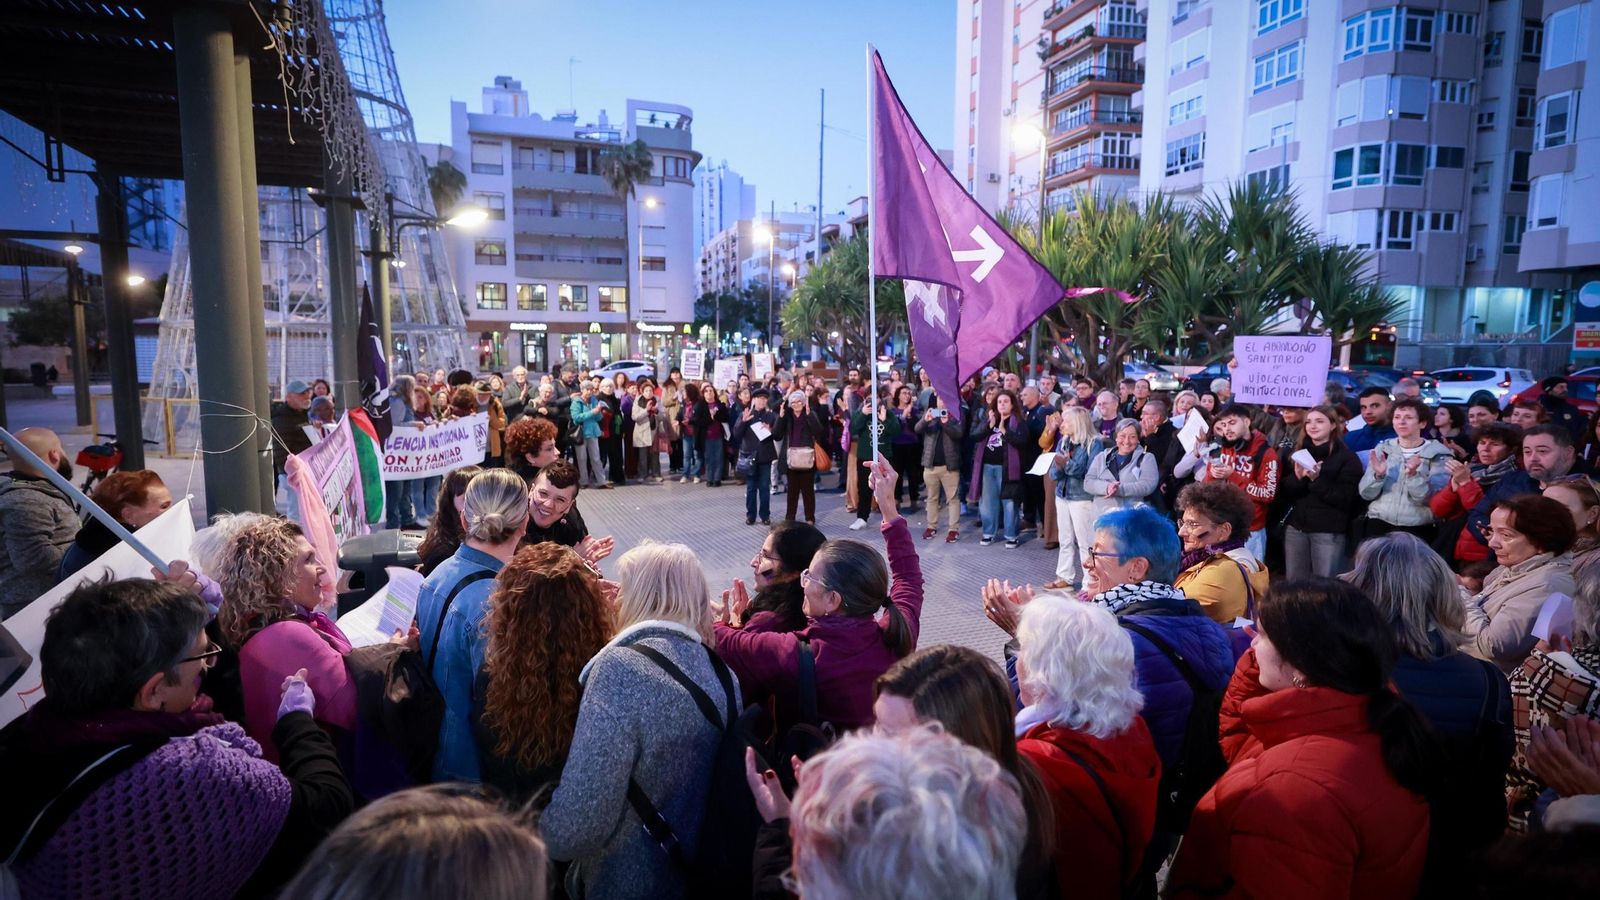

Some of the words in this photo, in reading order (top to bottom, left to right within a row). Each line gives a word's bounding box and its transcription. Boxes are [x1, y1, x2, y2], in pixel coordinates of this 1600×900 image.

[1245, 342, 1257, 352] EL
[1247, 354, 1305, 364] SANITARIO
[1241, 385, 1312, 398] INSTITUCIONAL
[415, 457, 423, 465] Y
